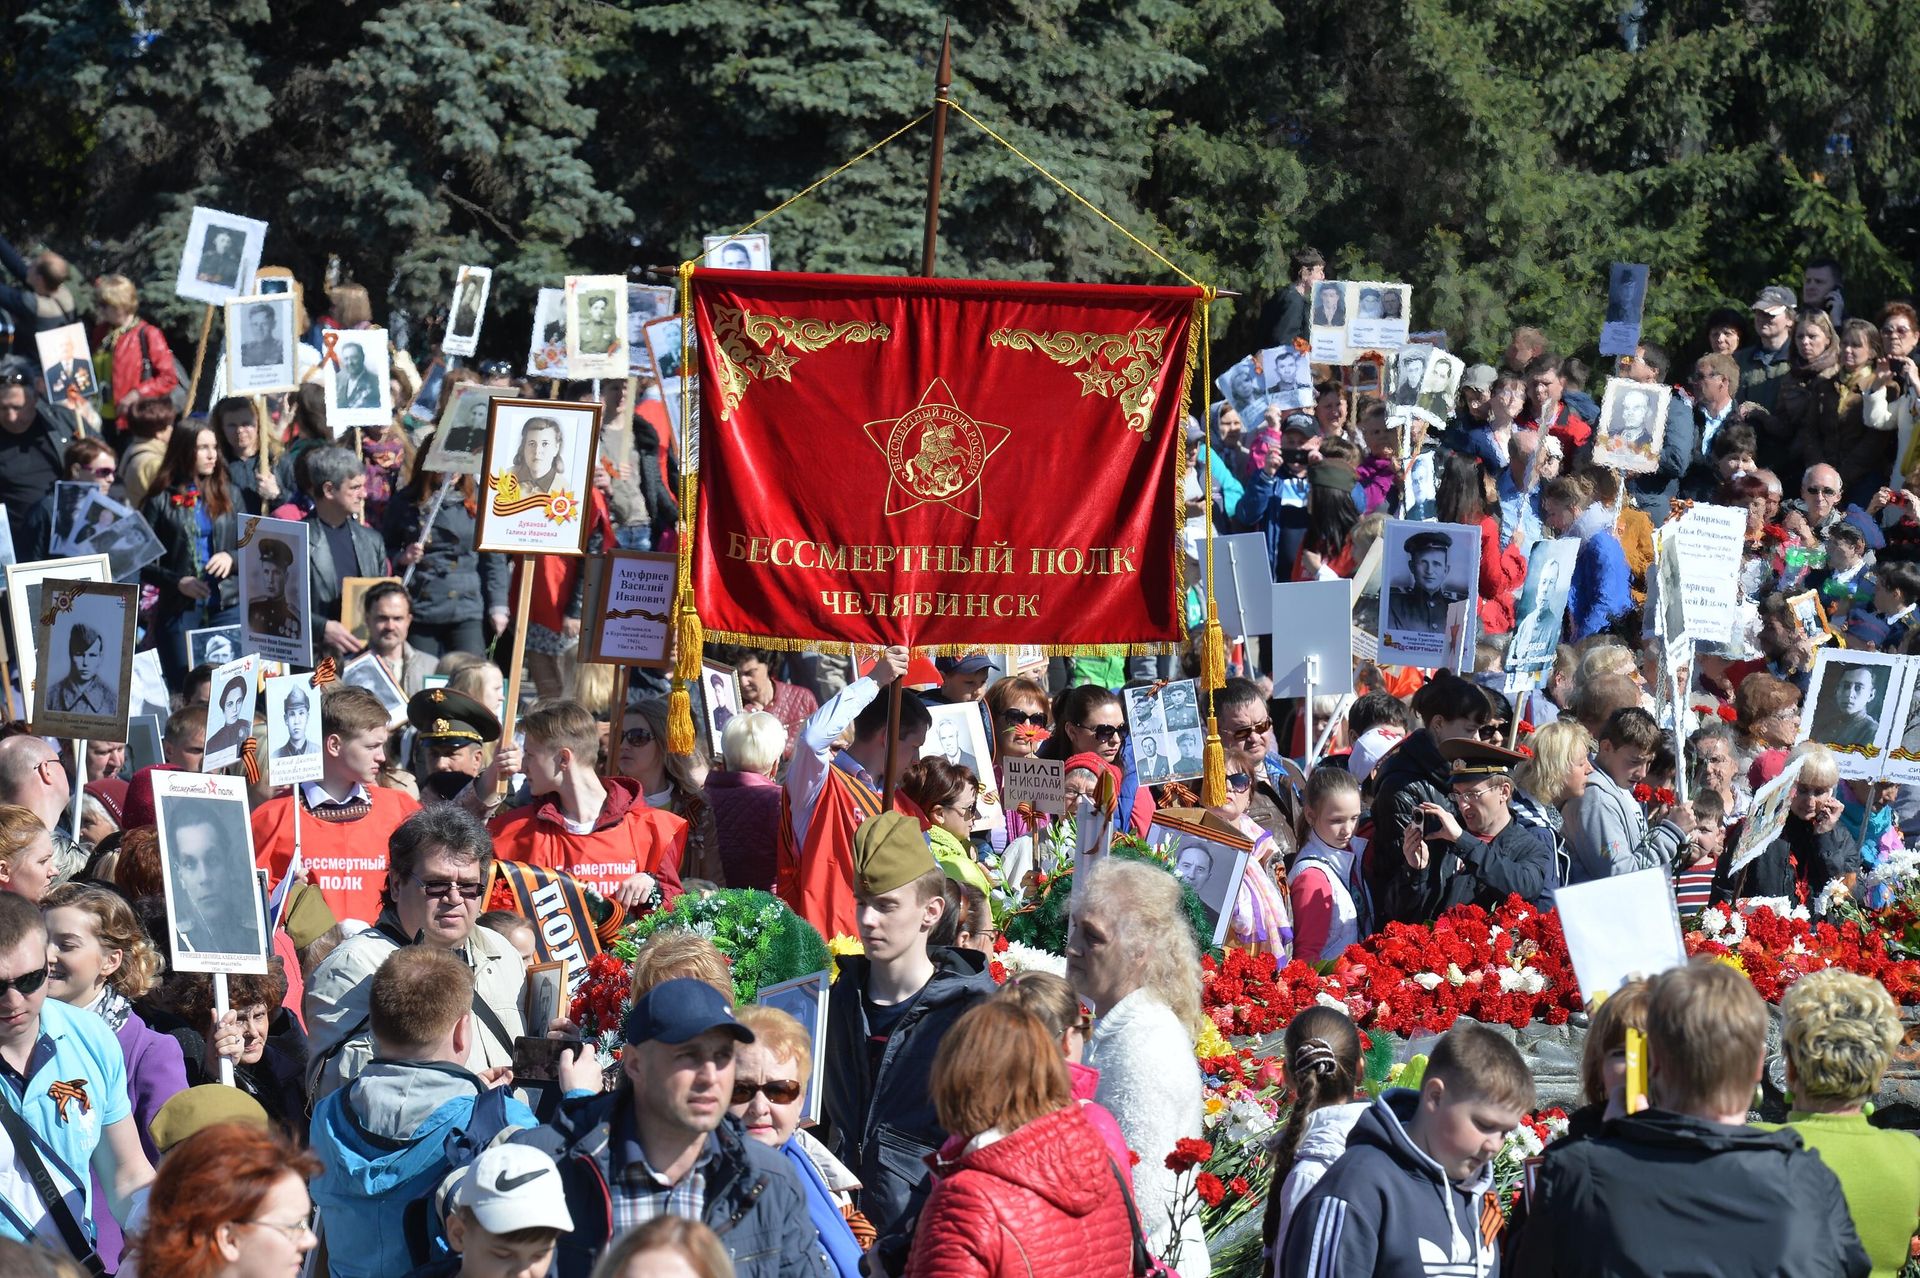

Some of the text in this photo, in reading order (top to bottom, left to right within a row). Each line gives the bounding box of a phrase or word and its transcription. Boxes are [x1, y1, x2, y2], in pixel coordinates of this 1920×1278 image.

[891, 406, 982, 476] БЕССМЕРТНЫЙ ПОЛК РОССИИ
[725, 532, 1136, 575] БЕССМЕРТНЫЙ ПОЛК
[618, 569, 669, 582] Ануфриев
[620, 580, 664, 593] Василий
[615, 591, 666, 605] Иванович
[820, 590, 1040, 617] ЧЕЛЯБИНСК
[1009, 761, 1060, 776] ШИЛО
[1009, 775, 1061, 789] НИКОЛАЙ
